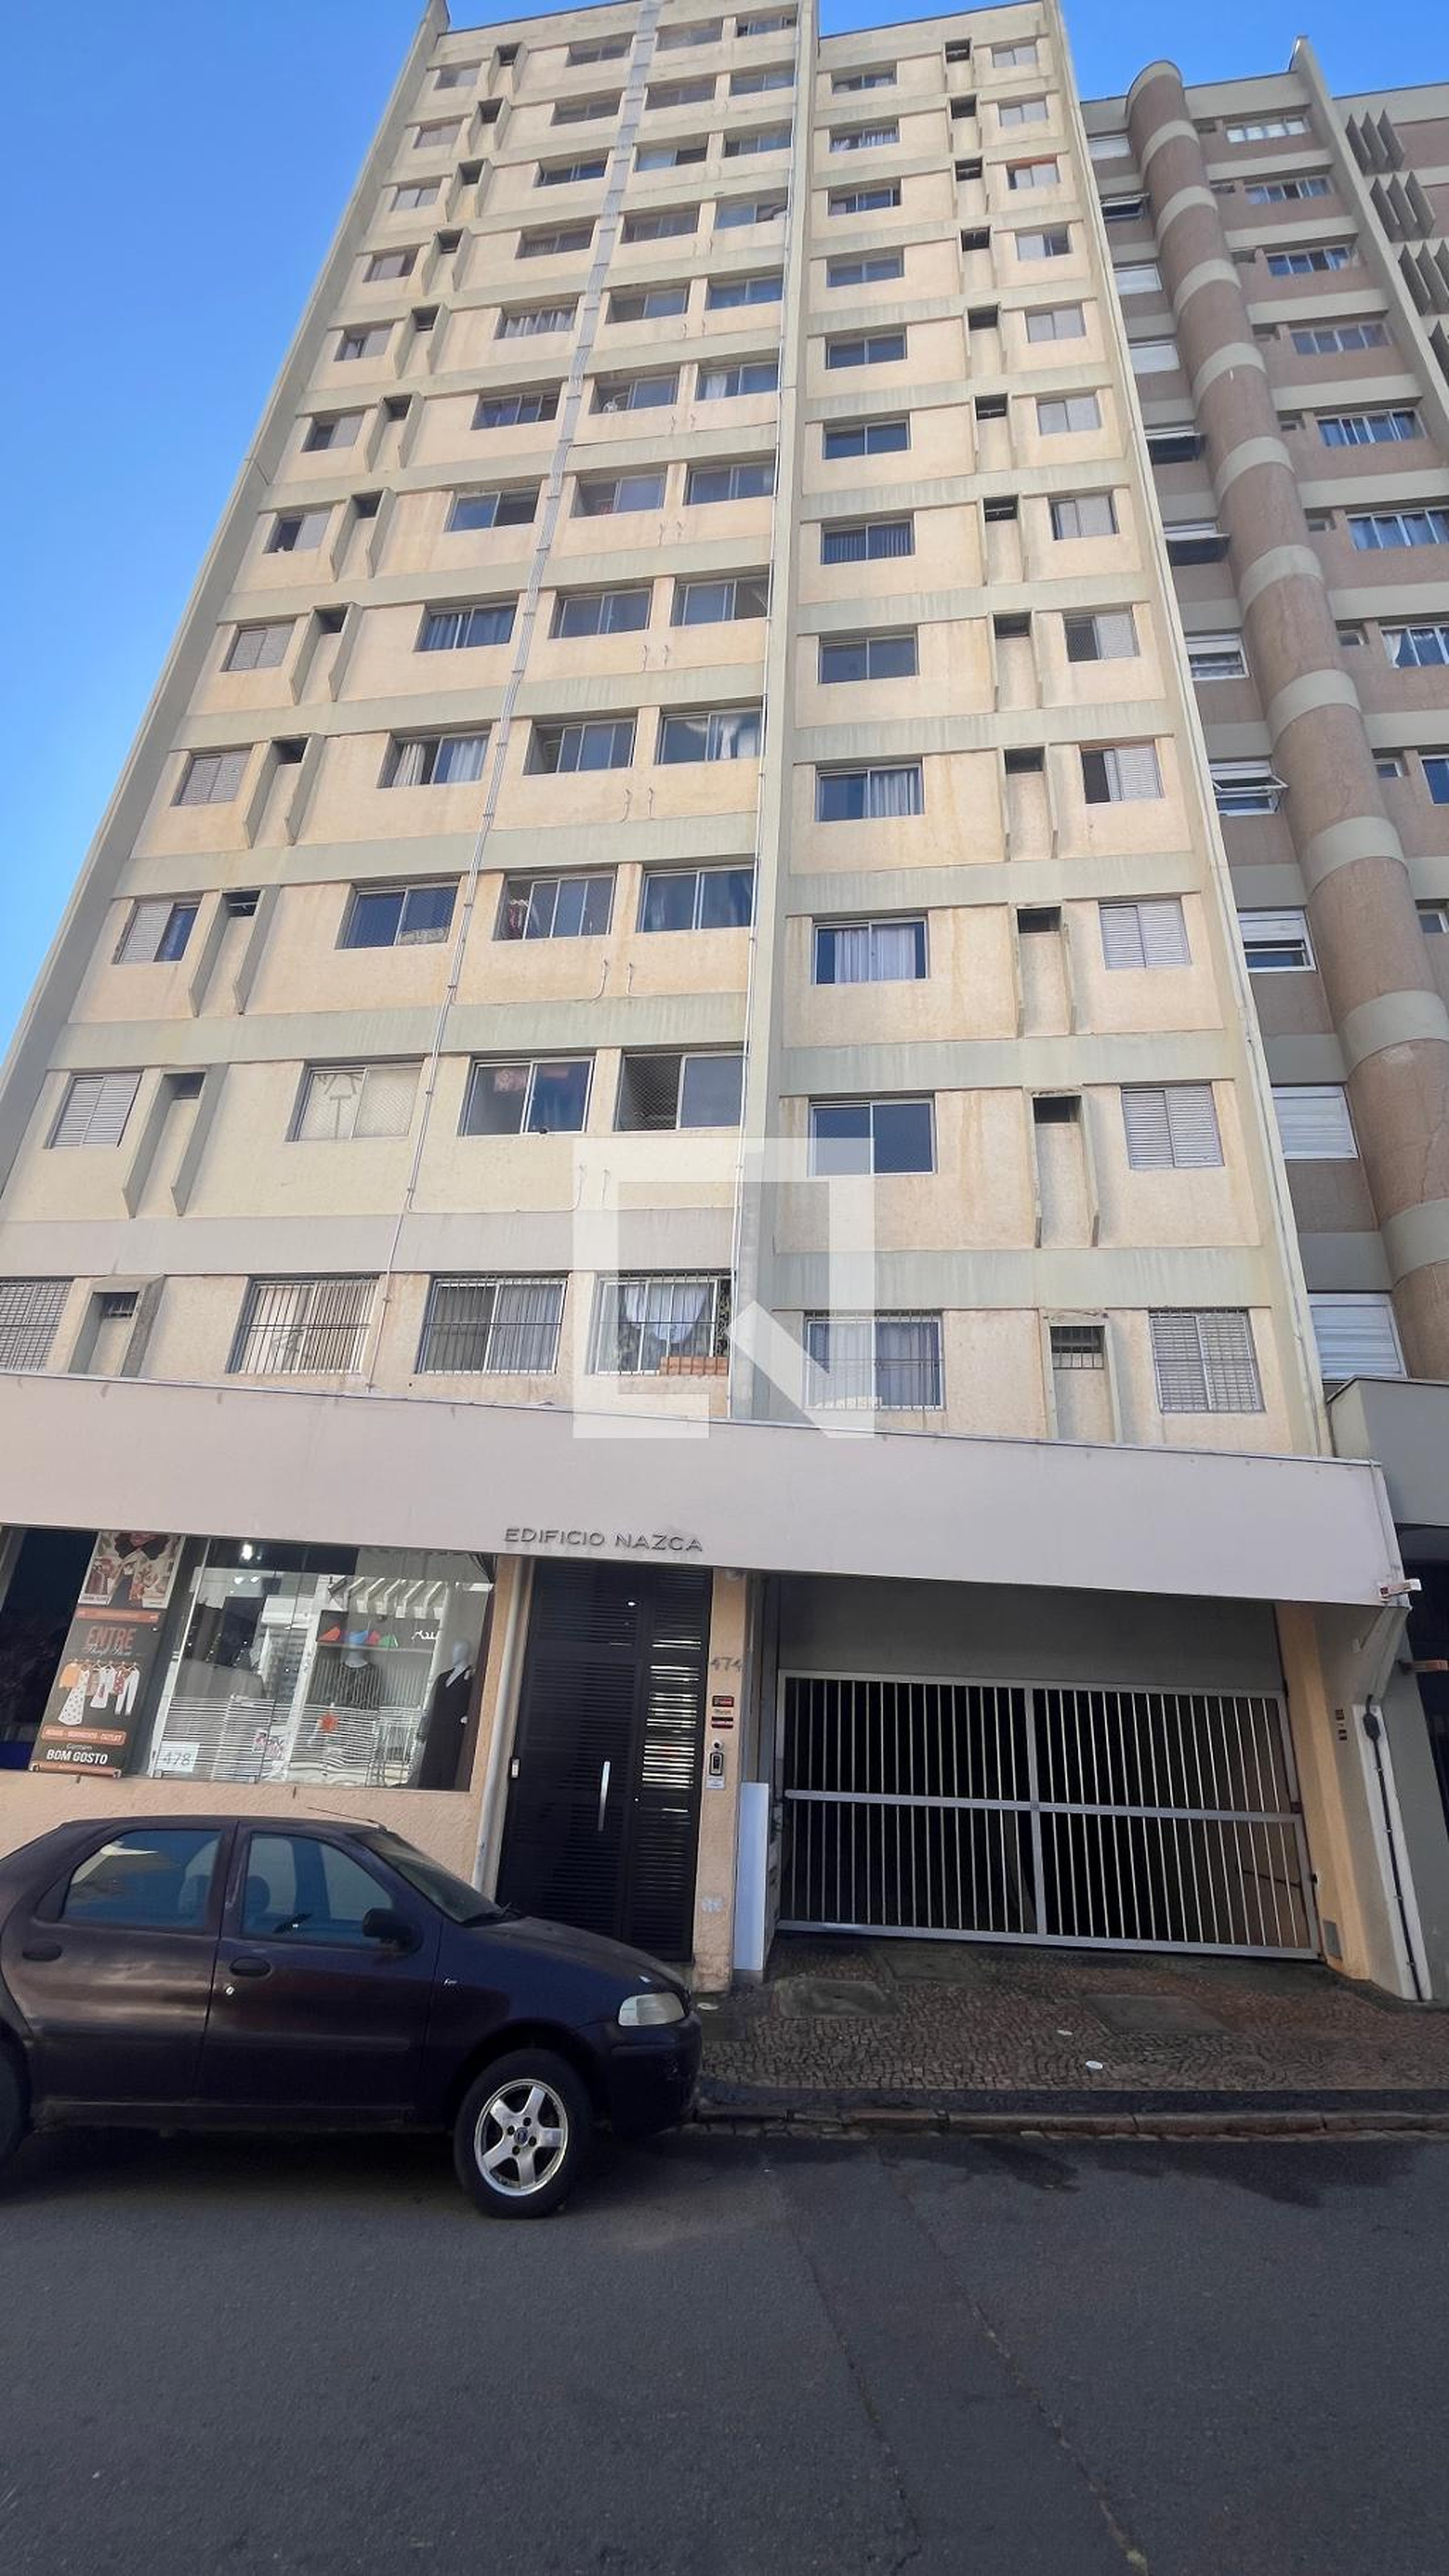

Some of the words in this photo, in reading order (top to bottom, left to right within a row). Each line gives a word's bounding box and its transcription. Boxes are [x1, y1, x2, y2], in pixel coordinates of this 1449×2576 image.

[505, 1528, 605, 1546] EDIFICIO
[615, 1533, 703, 1552] NAZCA
[87, 1626, 136, 1652] ENTRE
[710, 1657, 741, 1672] 474
[46, 1749, 72, 1761] BOM
[73, 1752, 108, 1765] GOSTO
